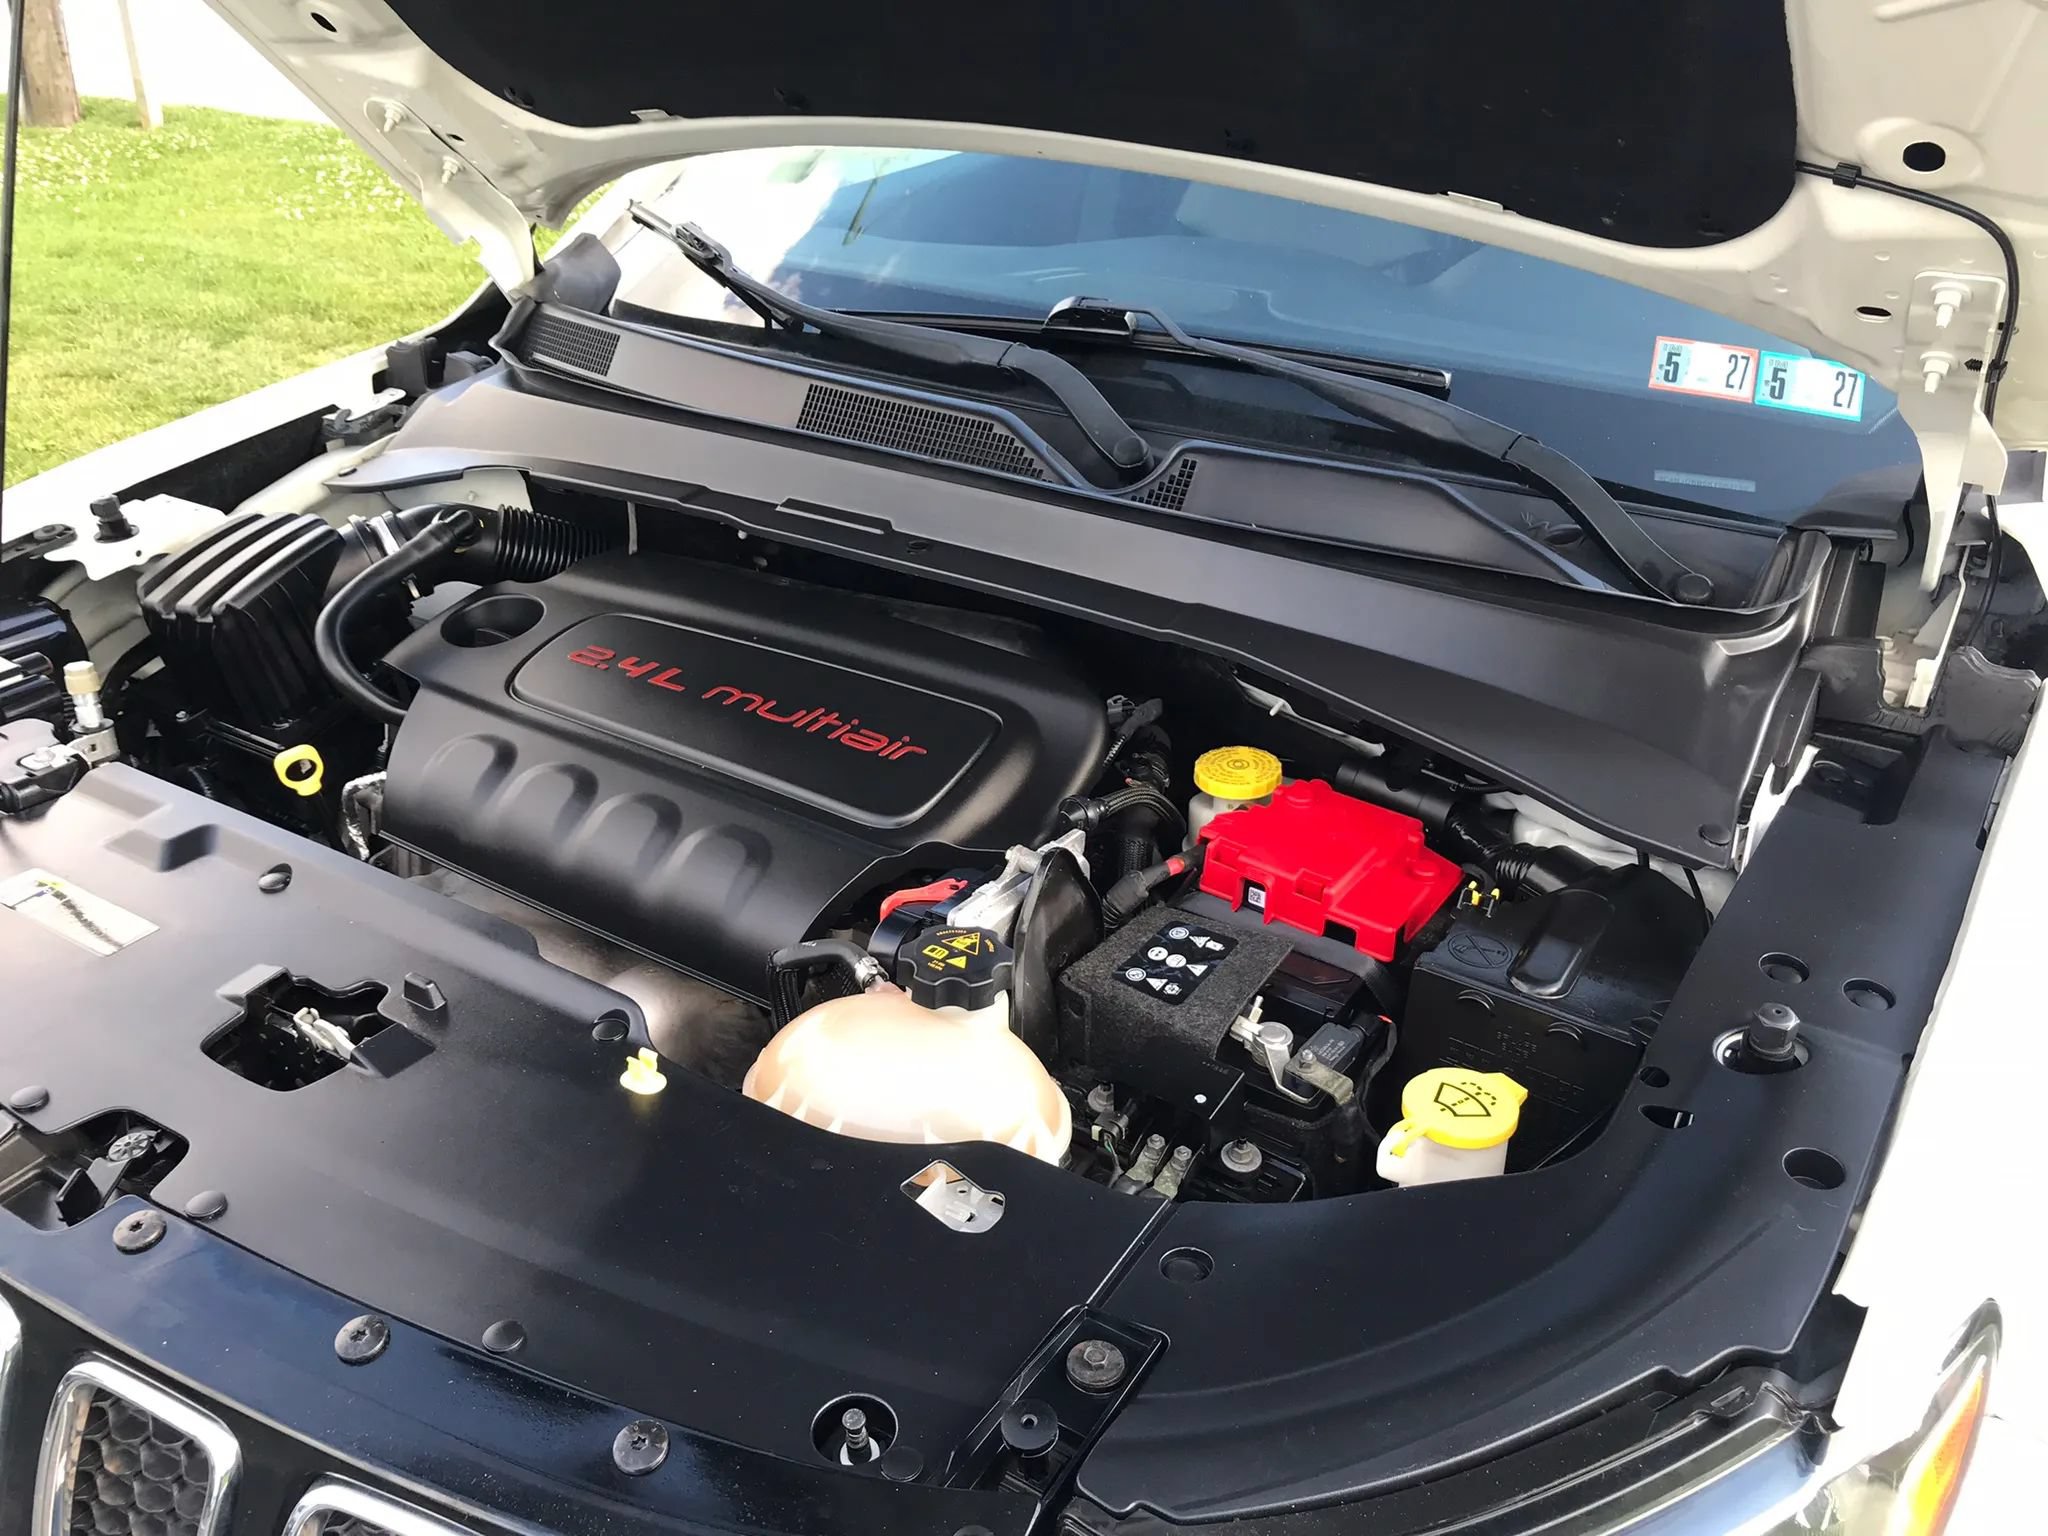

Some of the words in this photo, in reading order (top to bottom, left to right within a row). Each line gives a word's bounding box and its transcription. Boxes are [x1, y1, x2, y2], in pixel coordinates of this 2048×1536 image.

[1663, 351, 1682, 383] 5
[1725, 353, 1751, 391] 27
[1769, 366, 1788, 400] 5
[1833, 370, 1858, 409] 27
[566, 644, 686, 692] 2.4L
[700, 684, 929, 761] multiair
